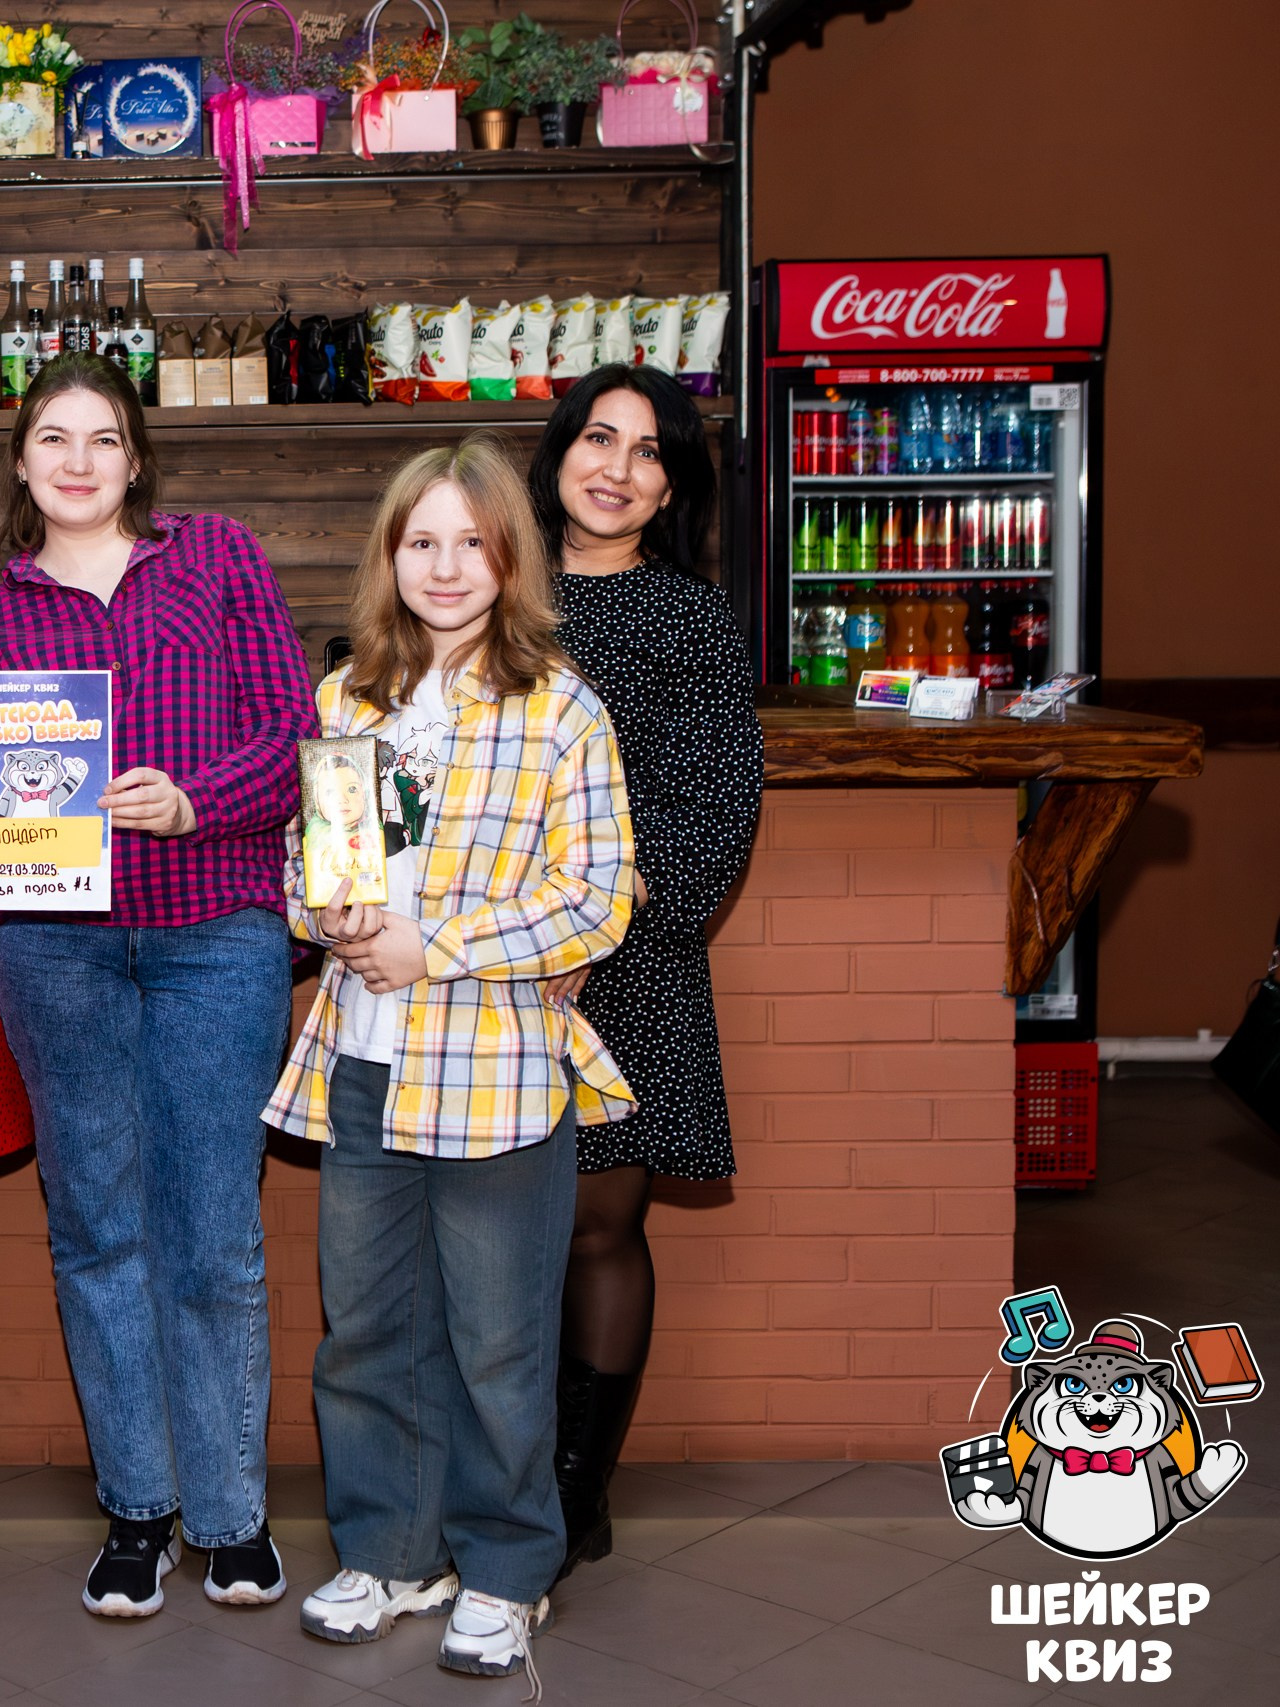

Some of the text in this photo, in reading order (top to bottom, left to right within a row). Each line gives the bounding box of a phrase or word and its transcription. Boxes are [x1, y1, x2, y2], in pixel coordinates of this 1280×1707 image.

[120, 99, 152, 116] Dolce
[811, 273, 1015, 340] Coca-Cola
[880, 368, 984, 383] 8-800-700-7777
[34, 684, 60, 693] КВИЗ
[34, 721, 100, 742] ВВЕРХ!
[25, 882, 67, 896] полов
[74, 876, 91, 892] #1
